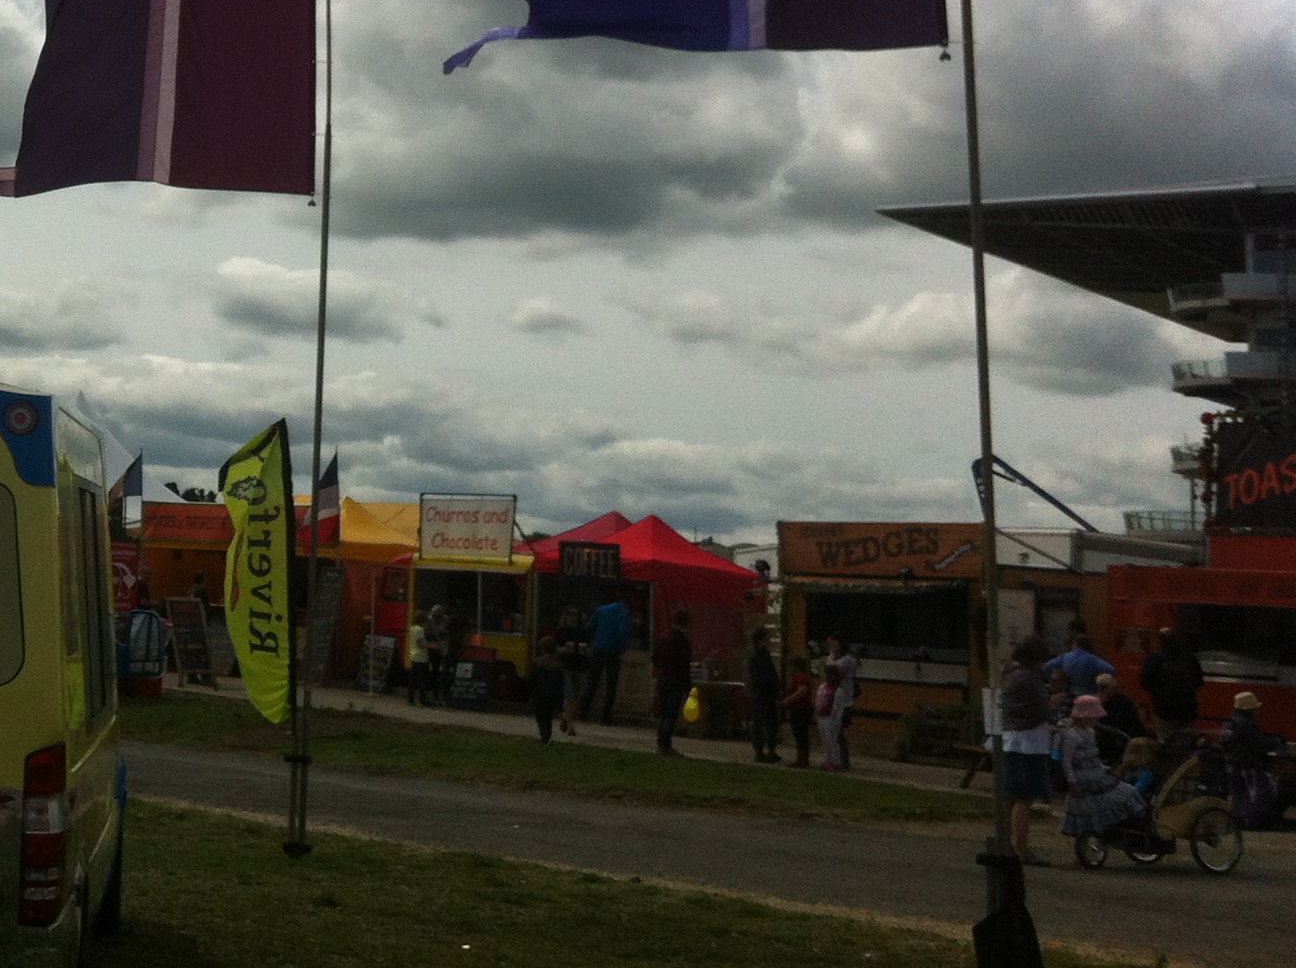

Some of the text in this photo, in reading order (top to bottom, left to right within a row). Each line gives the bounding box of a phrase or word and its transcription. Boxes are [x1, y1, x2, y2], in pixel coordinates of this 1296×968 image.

[483, 507, 510, 524] and
[431, 532, 499, 552] Chocolate
[815, 527, 939, 568] WEDGES
[563, 545, 618, 580] COFFEE
